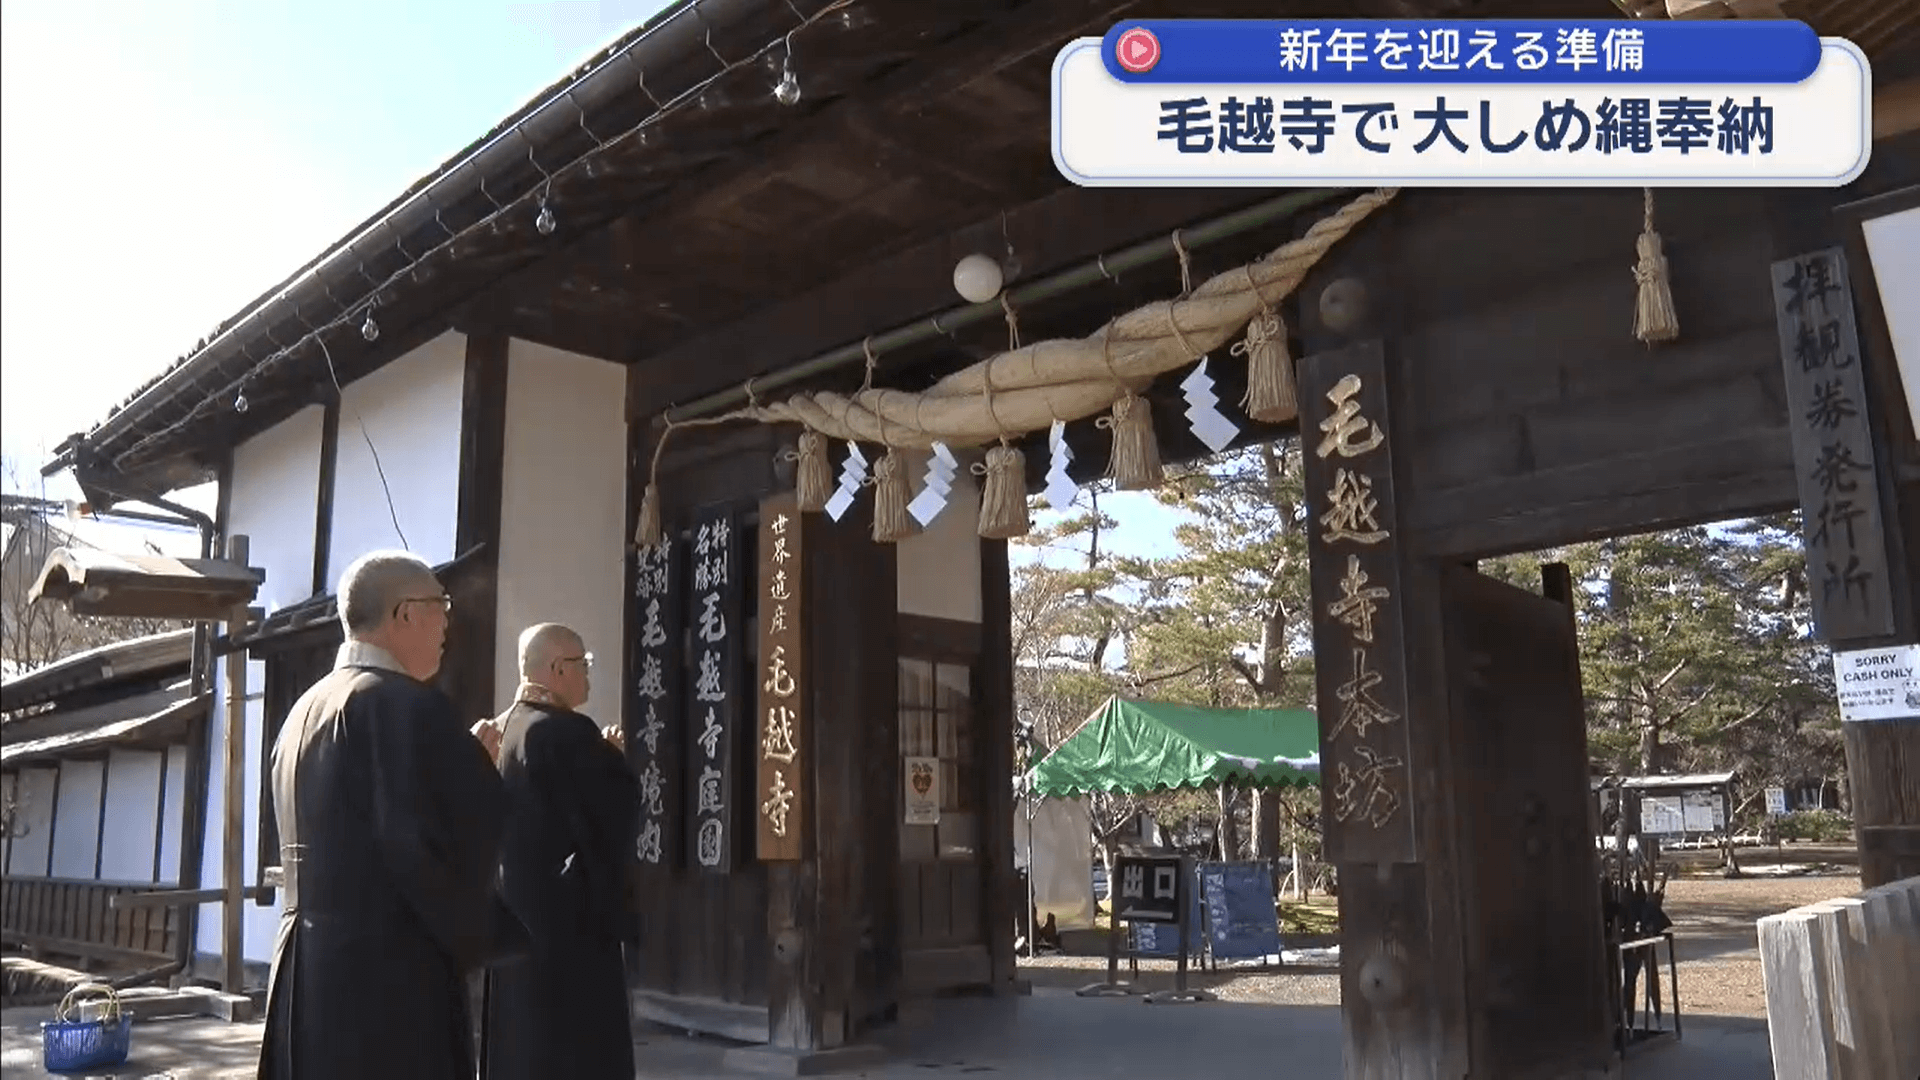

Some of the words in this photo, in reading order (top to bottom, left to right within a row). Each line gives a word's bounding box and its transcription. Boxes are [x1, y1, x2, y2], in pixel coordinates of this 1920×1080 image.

[1782, 256, 1873, 618] 拝観券発行所
[768, 512, 792, 636] 世界遺産
[1315, 373, 1403, 829] 毛越寺本坊
[1843, 670, 1878, 682] CASH
[1881, 667, 1914, 680] ONLY
[1855, 654, 1897, 668] SORRY
[762, 645, 798, 838] 毛越寺
[1121, 864, 1176, 899] 出口
